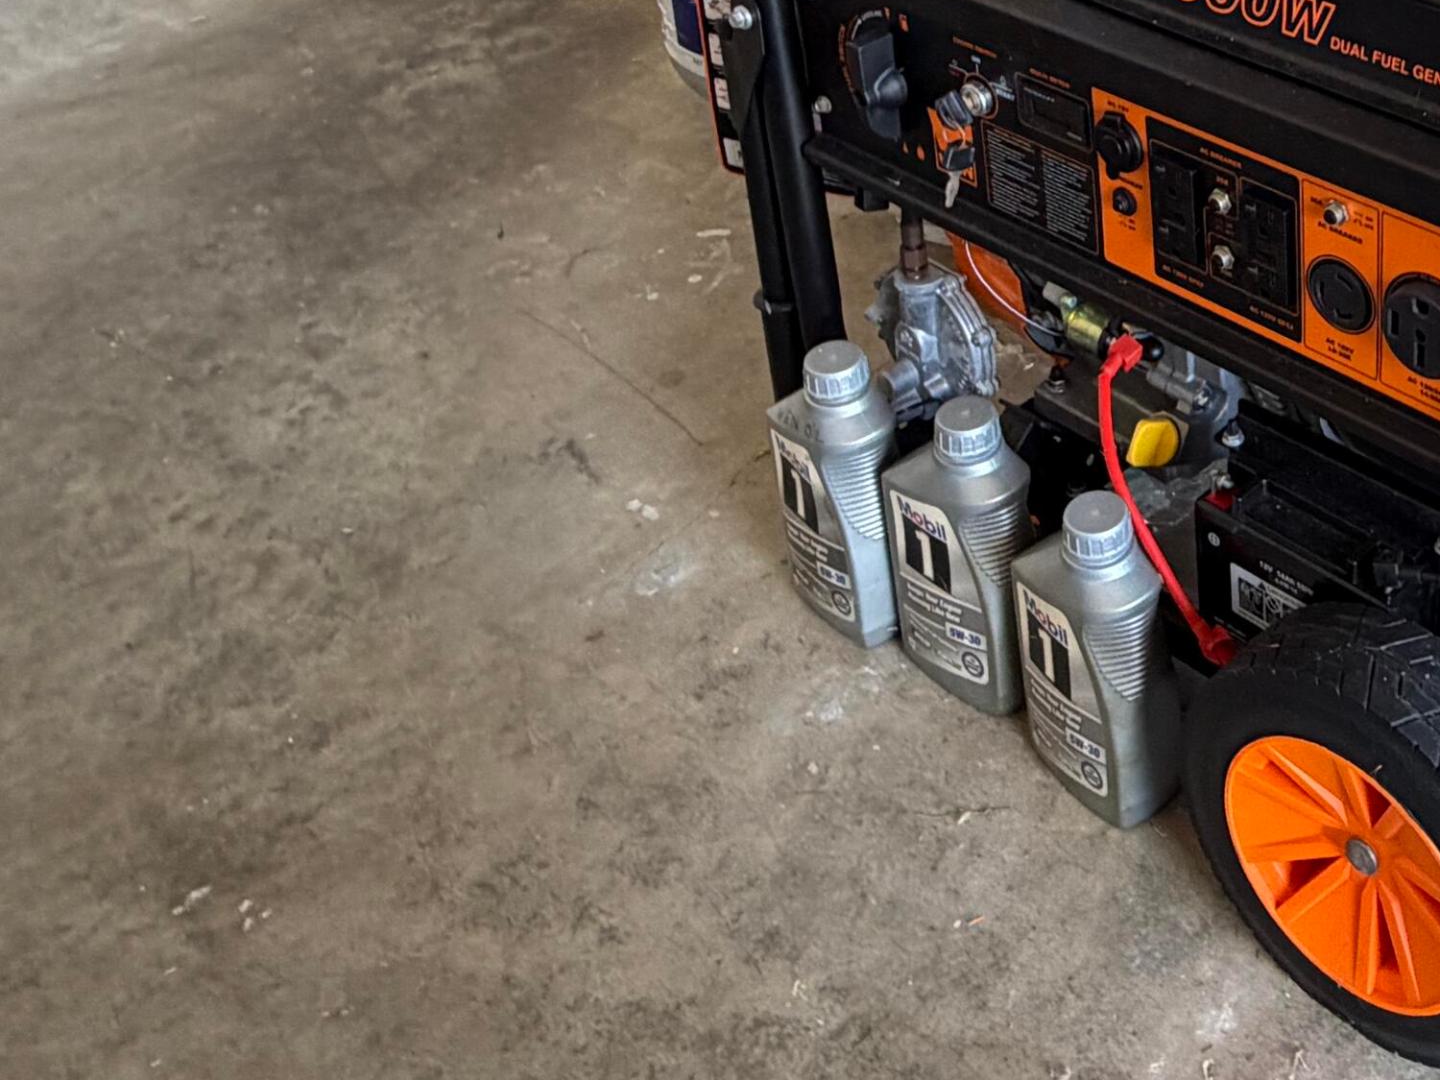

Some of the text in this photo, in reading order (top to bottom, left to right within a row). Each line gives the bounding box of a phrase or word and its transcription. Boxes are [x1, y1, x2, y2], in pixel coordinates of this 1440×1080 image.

[1329, 35, 1369, 62] DUAL
[1371, 50, 1409, 76] FUEL
[791, 469, 806, 519] 1
[896, 495, 946, 542] Mobil
[915, 530, 935, 582] 1
[949, 626, 982, 647] 5W-30
[1023, 588, 1068, 647] Mobil
[1038, 627, 1056, 683] 1
